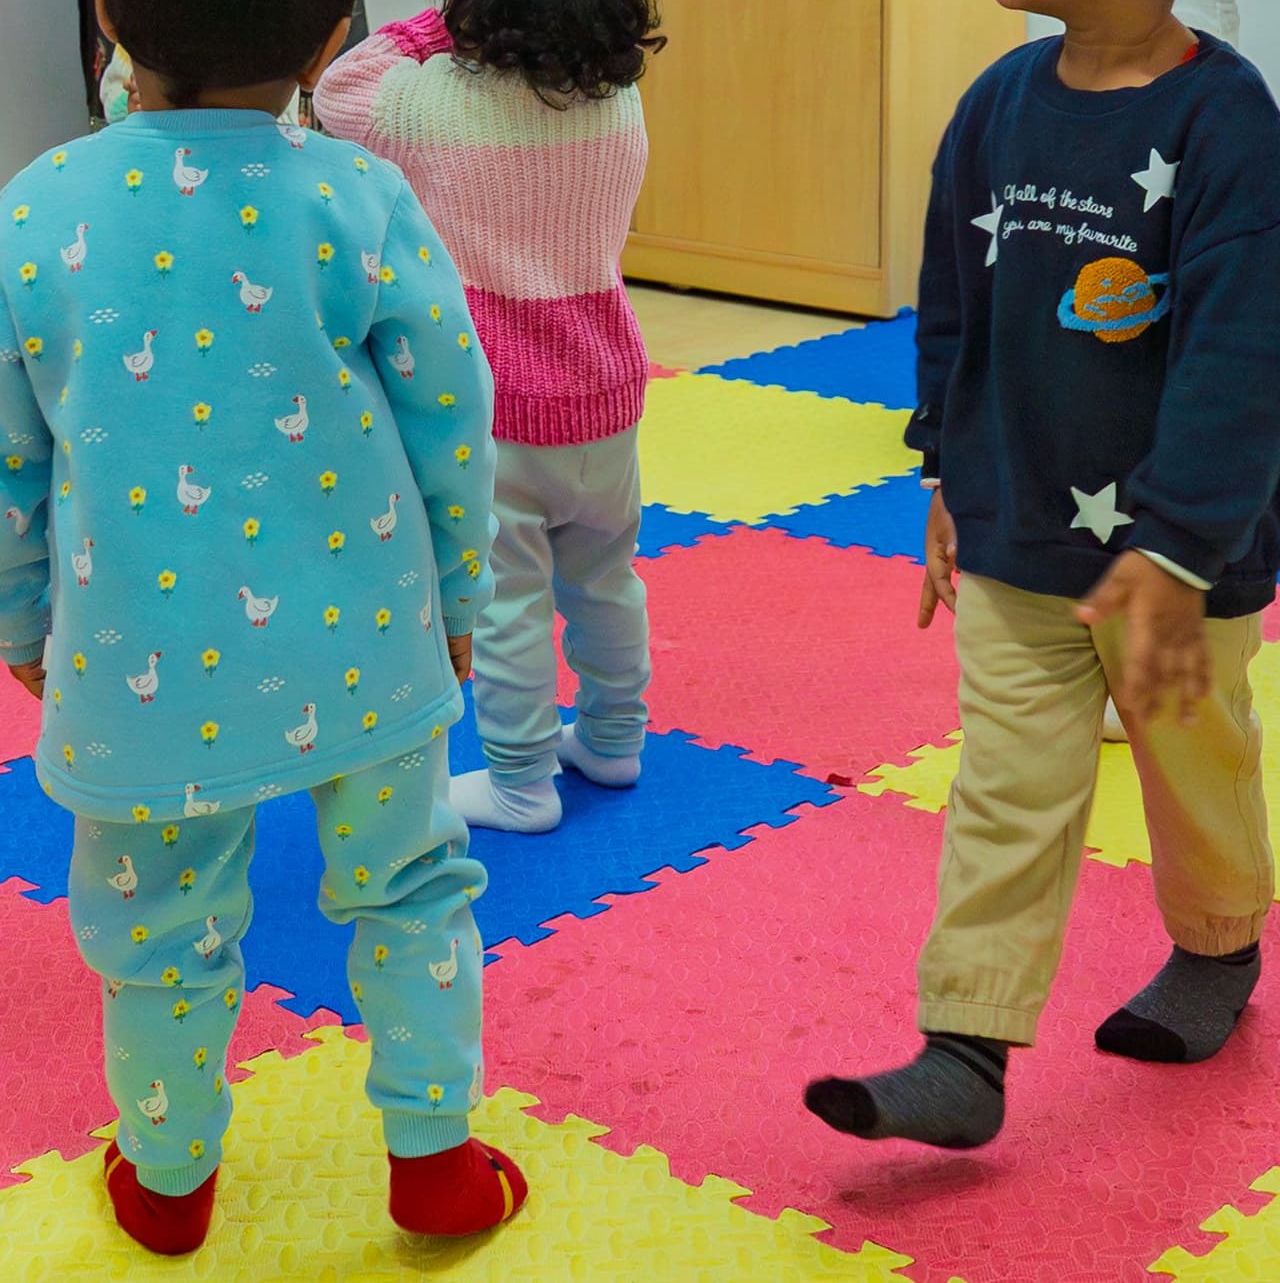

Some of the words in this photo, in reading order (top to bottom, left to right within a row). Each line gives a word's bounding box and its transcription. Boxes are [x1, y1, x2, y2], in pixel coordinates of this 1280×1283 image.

[1016, 184, 1038, 201] all
[1040, 187, 1056, 209] of
[1060, 189, 1078, 210] the
[1079, 196, 1114, 218] stars
[1002, 220, 1024, 239] you
[1027, 220, 1052, 231] are
[1055, 224, 1076, 245] my
[1076, 222, 1138, 252] favourite
